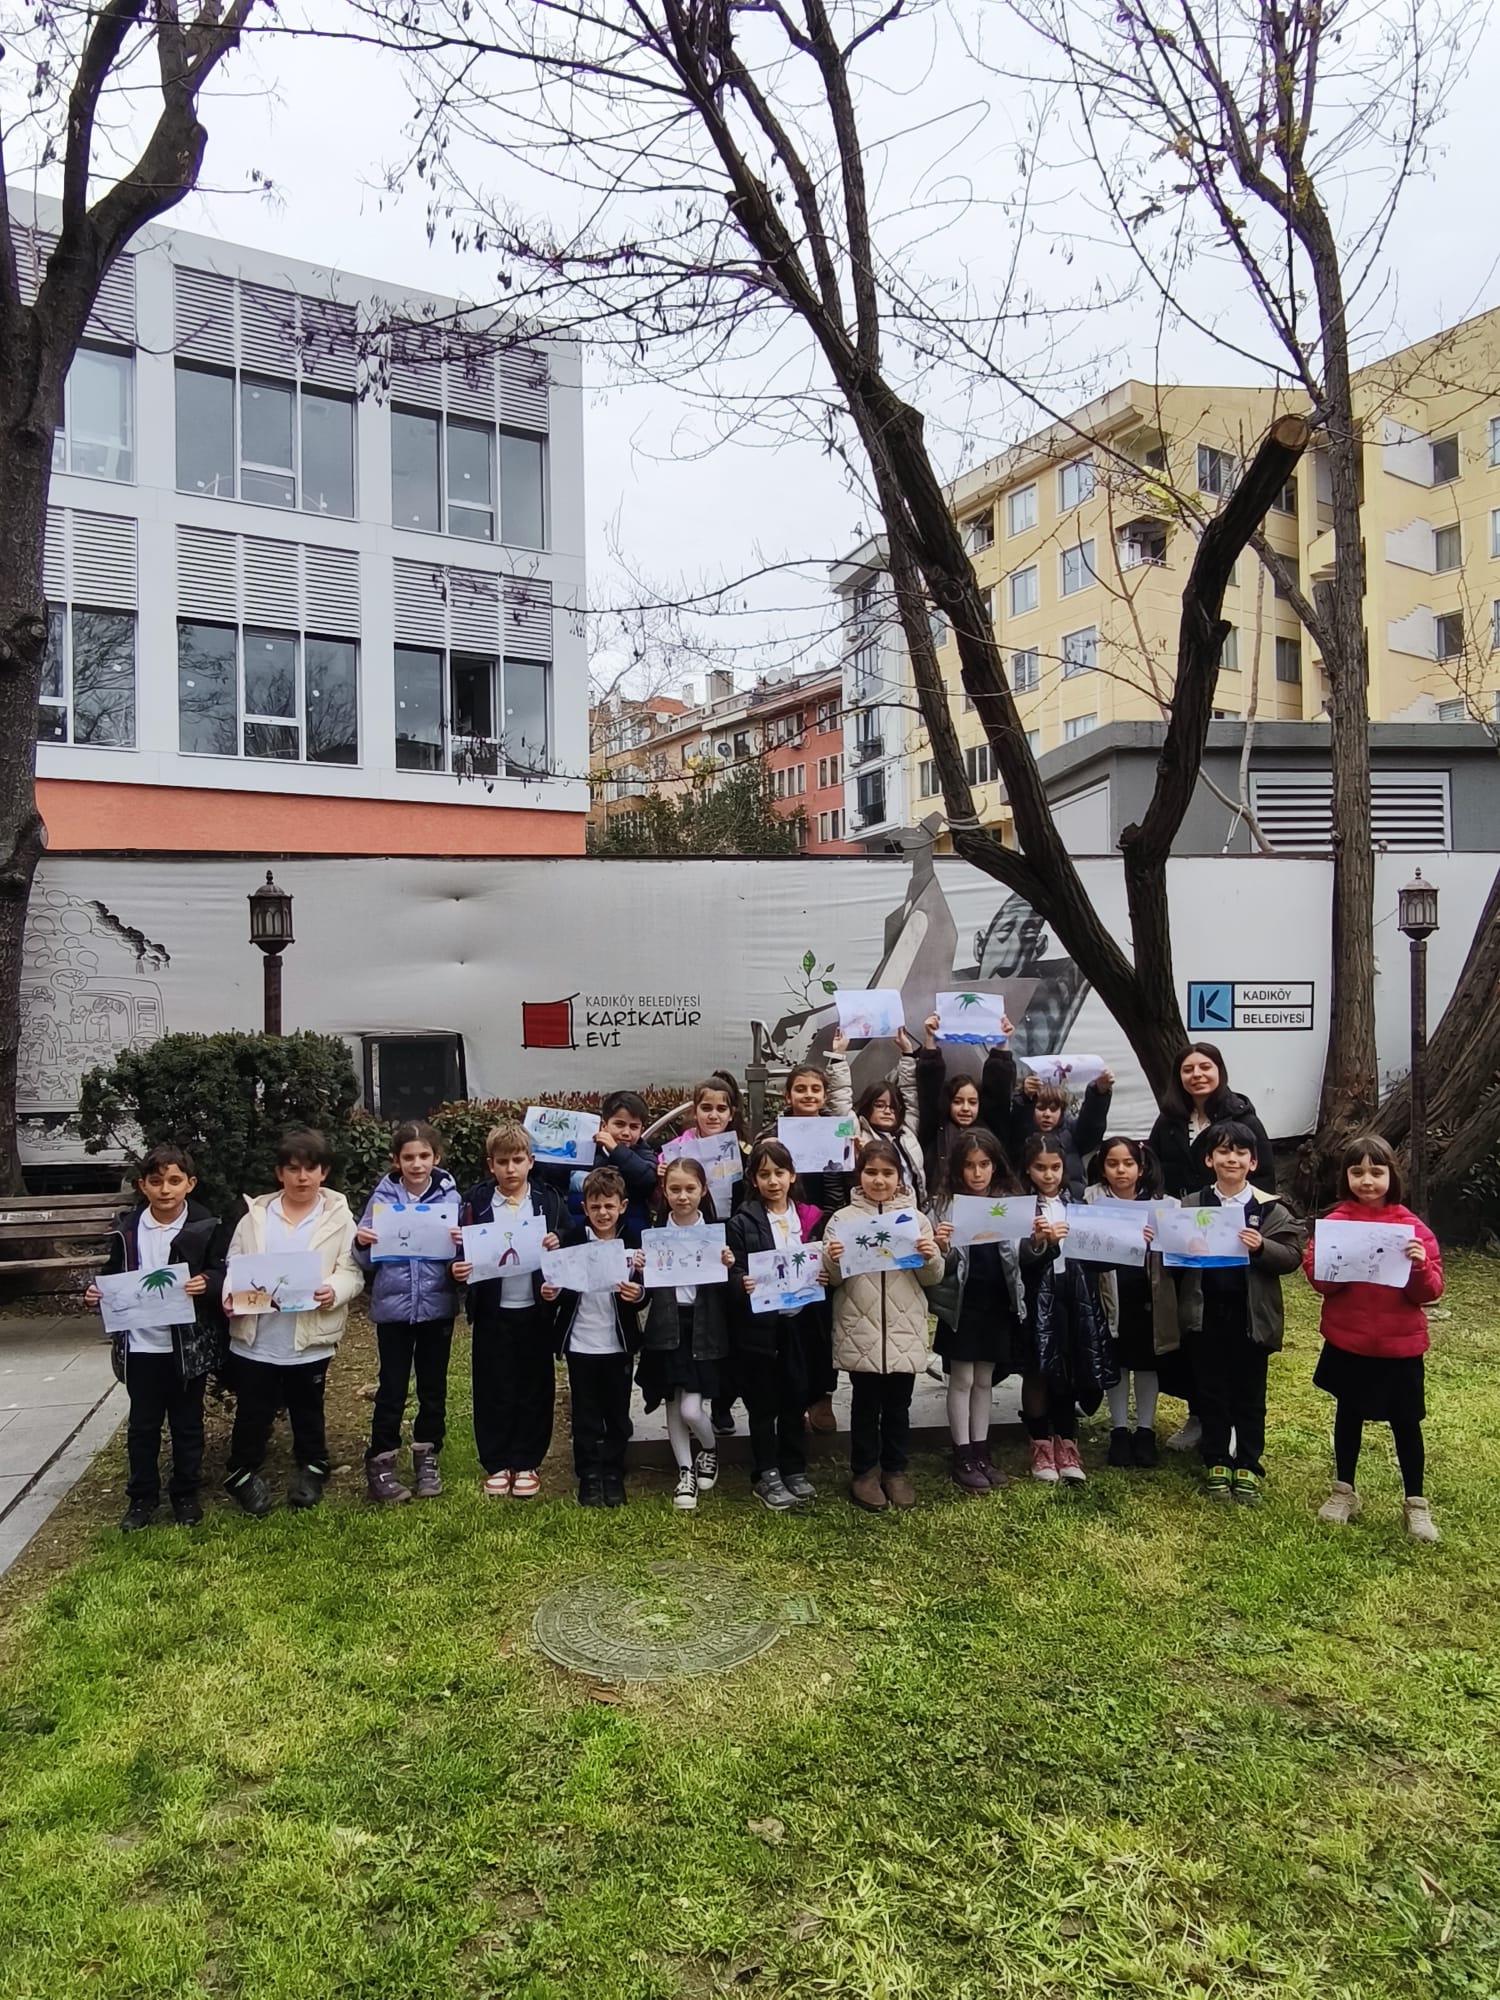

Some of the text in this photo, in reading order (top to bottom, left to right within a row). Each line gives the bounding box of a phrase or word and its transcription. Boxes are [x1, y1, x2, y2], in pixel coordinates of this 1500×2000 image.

[586, 993, 701, 1007] KADIKÖY BELEDİYESİ
[1243, 988, 1292, 1001] KADIKÖY
[586, 1008, 702, 1026] KARİKATÜR
[1243, 1011, 1305, 1024] BELEDİYESİ
[586, 1028, 621, 1047] EVİ
